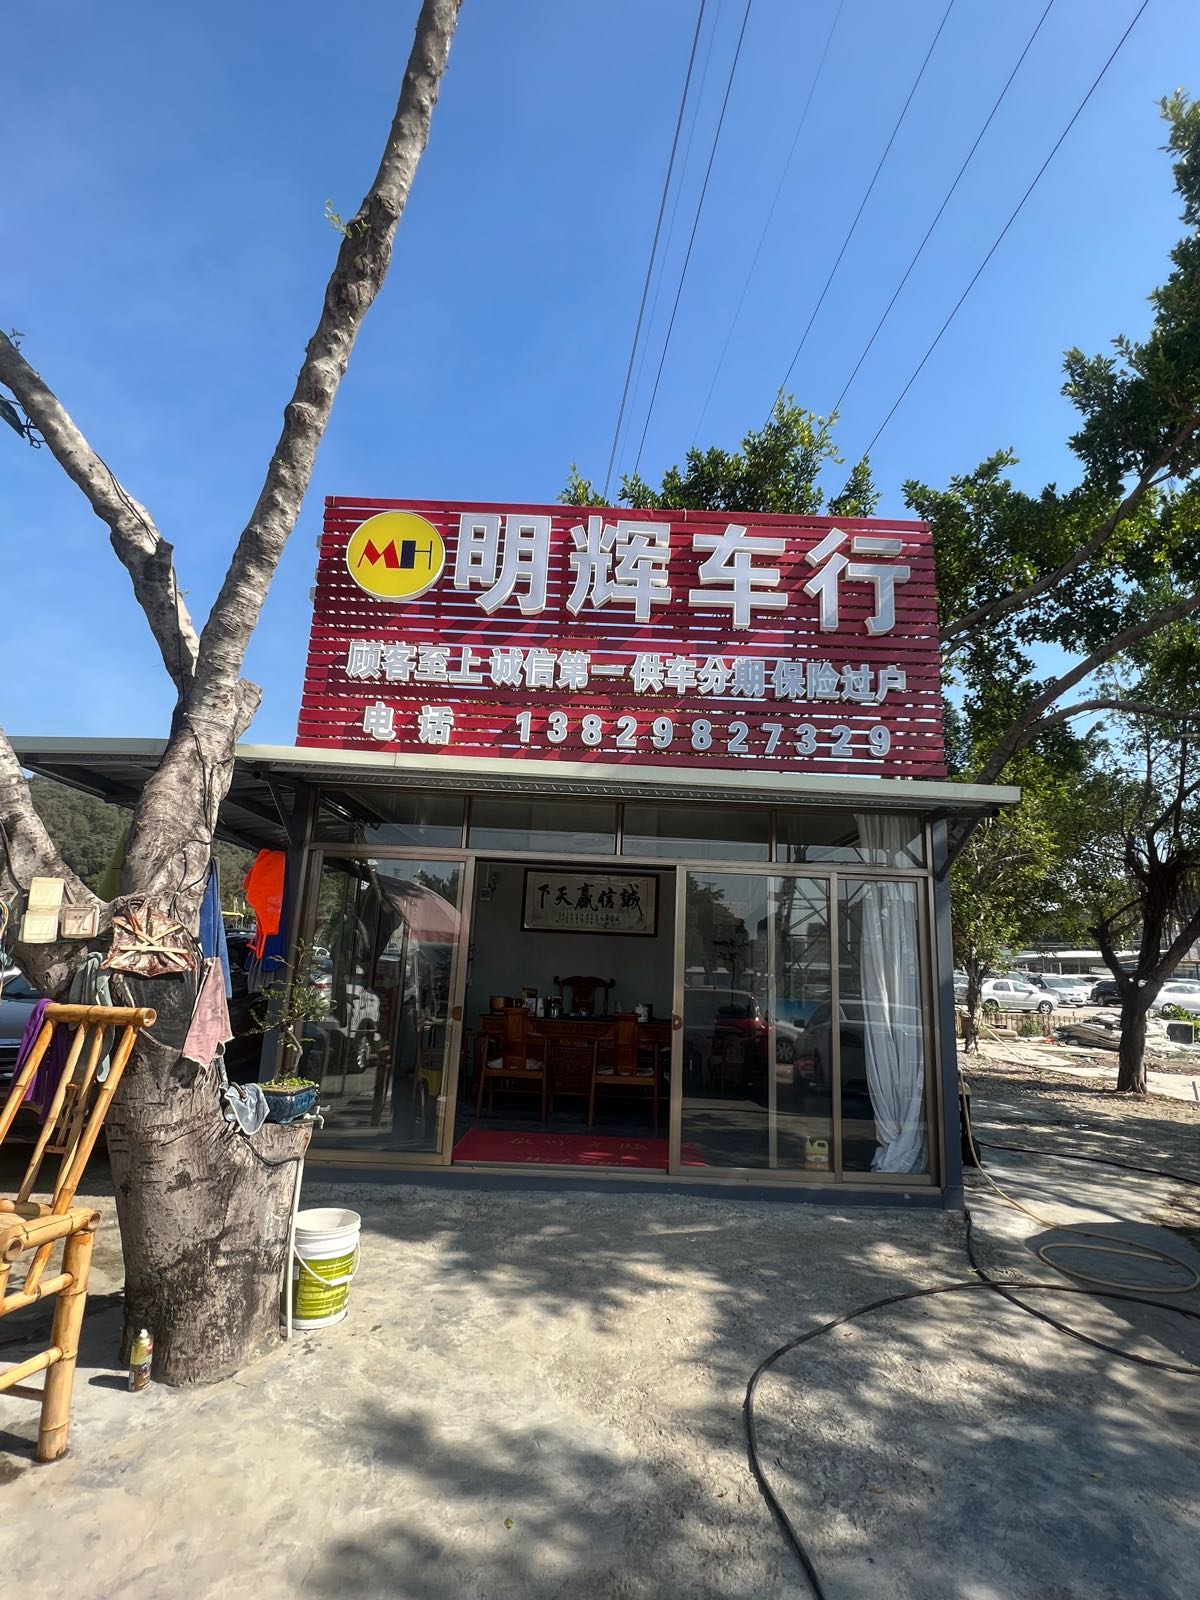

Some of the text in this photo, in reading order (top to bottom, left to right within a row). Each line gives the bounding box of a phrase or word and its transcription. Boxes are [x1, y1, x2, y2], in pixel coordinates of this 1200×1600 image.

[454, 513, 911, 636] 明辉车行
[362, 701, 891, 757] 电话 13829827329
